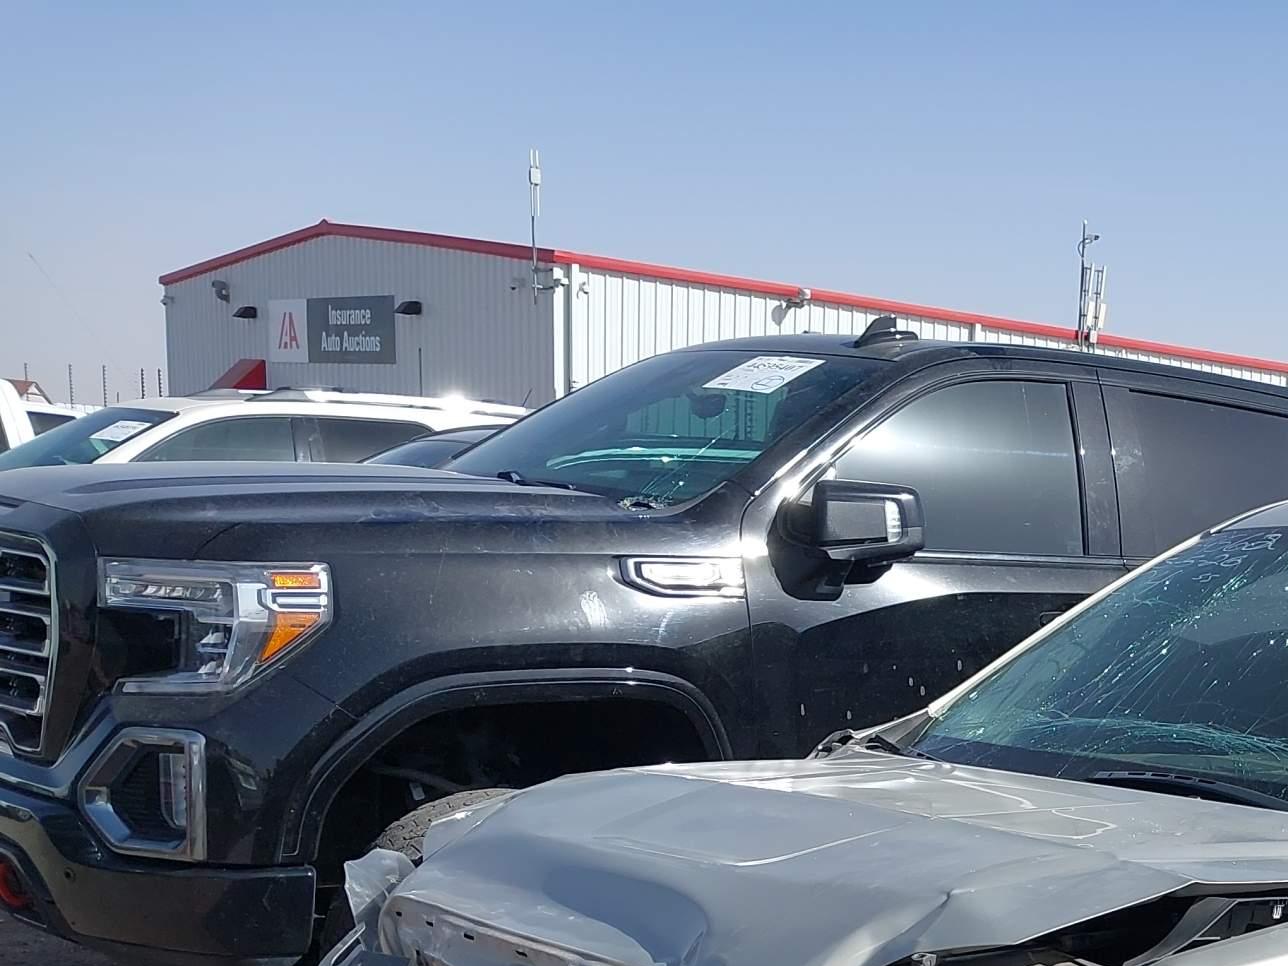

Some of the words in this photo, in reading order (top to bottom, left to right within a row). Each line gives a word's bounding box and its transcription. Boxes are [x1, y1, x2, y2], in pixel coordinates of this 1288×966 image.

[328, 304, 371, 326] Insurance
[321, 331, 341, 352] Auto
[342, 330, 381, 352] Auctions
